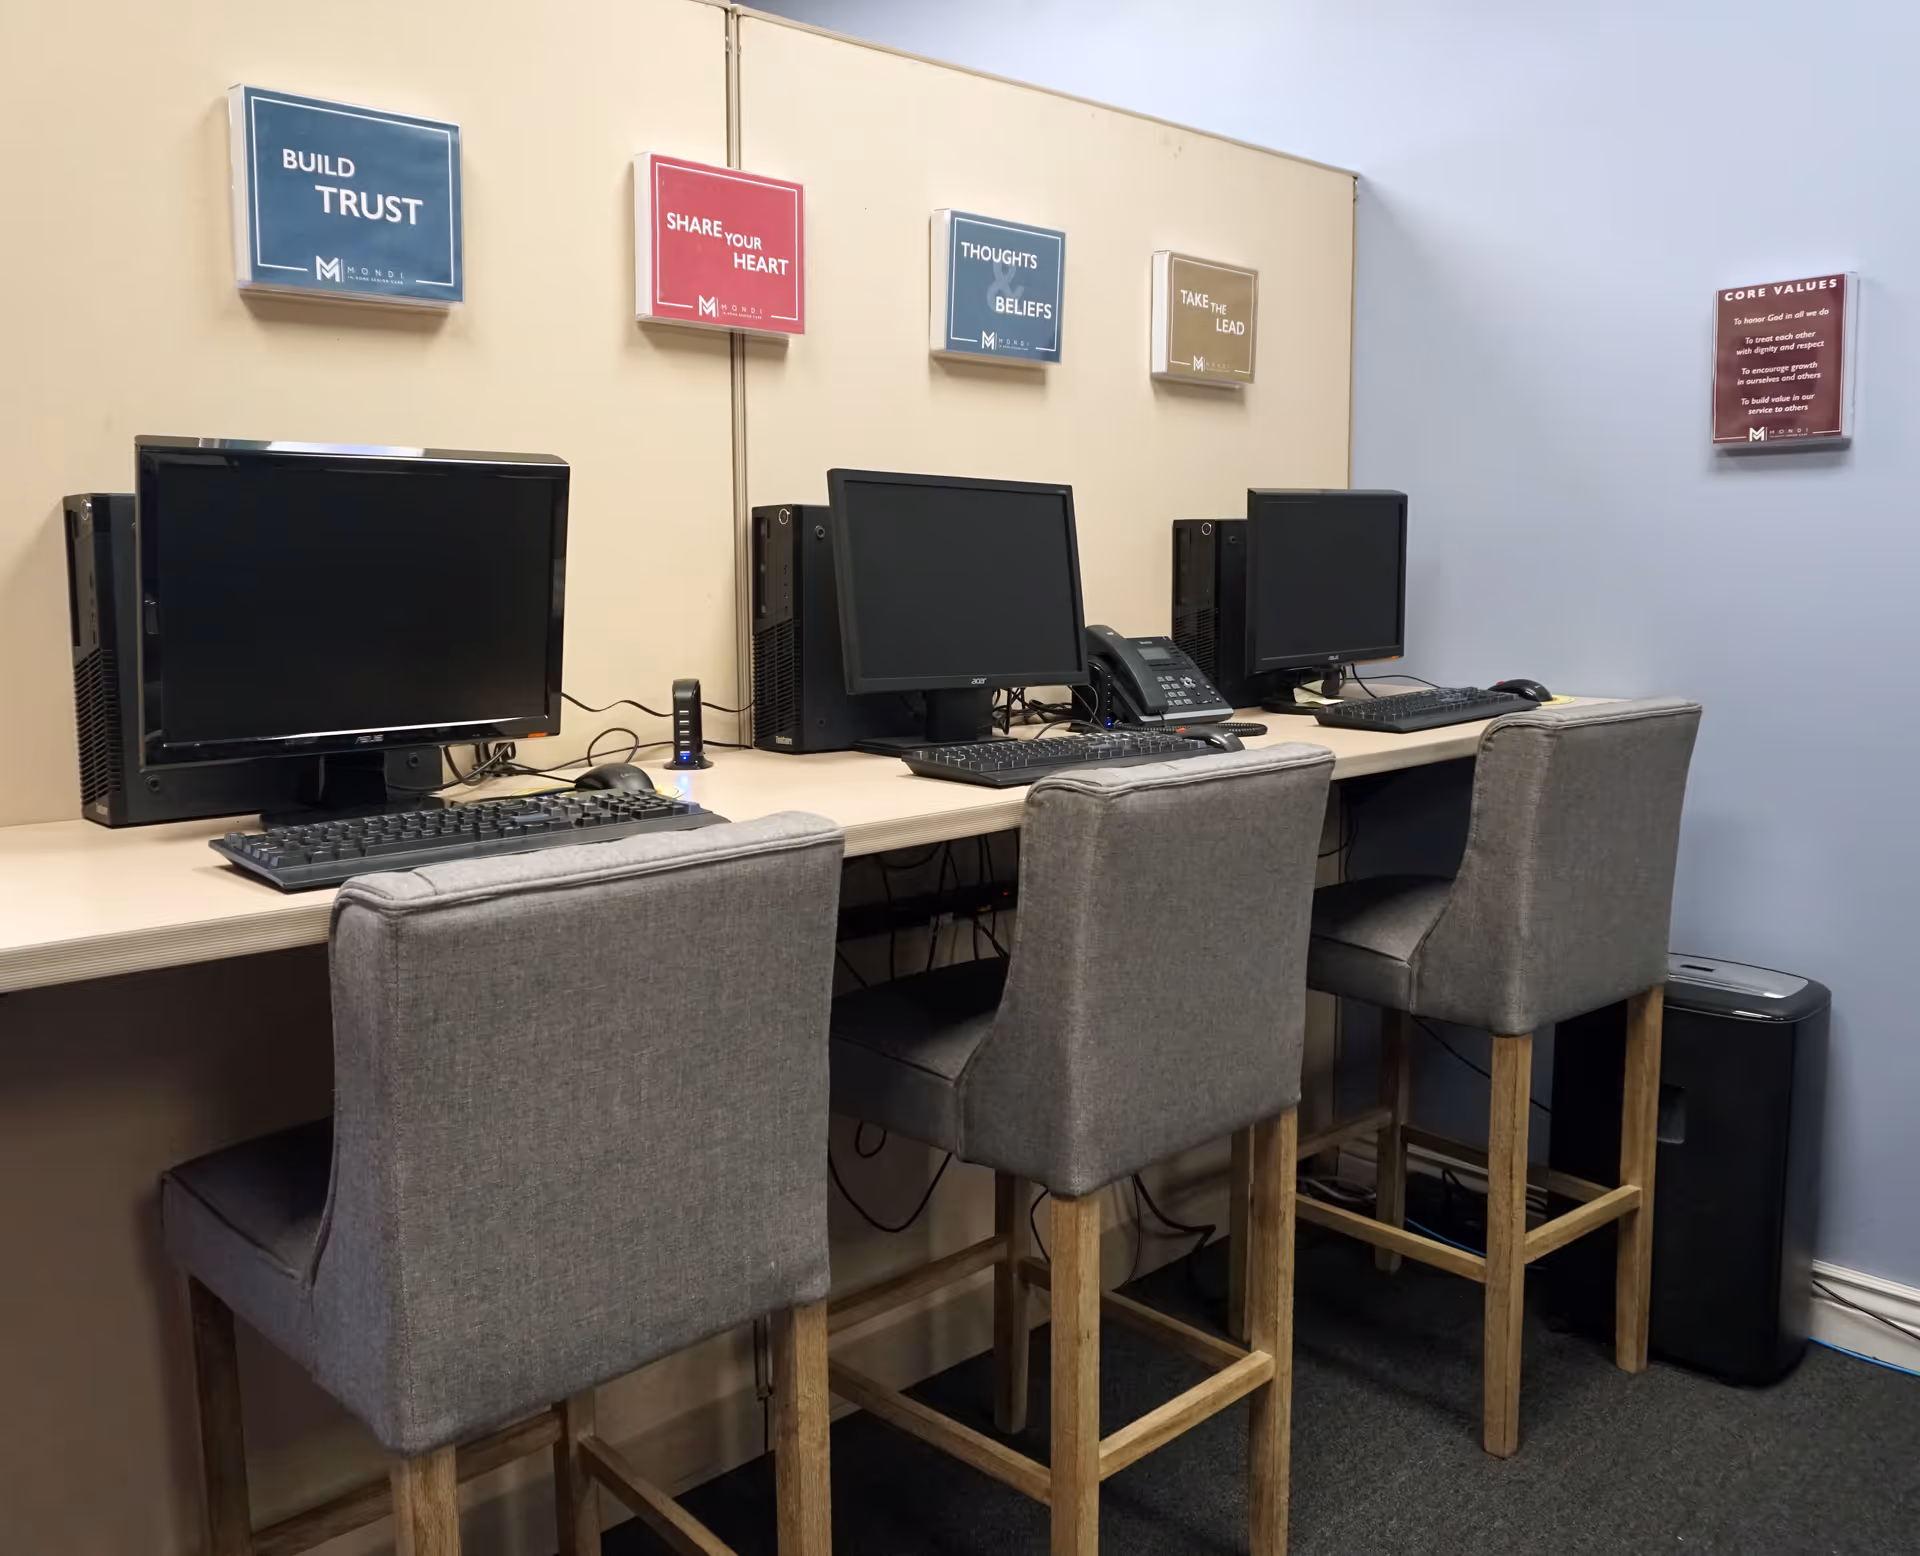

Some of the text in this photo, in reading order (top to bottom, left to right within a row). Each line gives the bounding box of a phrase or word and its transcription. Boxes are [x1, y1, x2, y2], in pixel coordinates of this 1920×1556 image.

[282, 148, 355, 178] BUILD
[315, 185, 423, 225] TRUST
[666, 212, 762, 250] SHARE YOUR
[734, 252, 789, 275] HEART
[961, 241, 1038, 269] THOUGHTS
[347, 266, 403, 279] MONDI
[1724, 279, 1837, 301] CORE VALUES
[721, 304, 762, 315] MONDI
[996, 296, 1052, 319] BELIEFS
[1180, 289, 1227, 315] TAKE THE
[1734, 318, 1742, 326] To
[1743, 316, 1765, 324] honor
[1767, 313, 1784, 322] God
[1785, 312, 1793, 320] in
[1794, 310, 1805, 319] all
[1819, 308, 1829, 316] do
[1216, 318, 1245, 335] LEAD
[1745, 331, 1816, 345] To treat each other
[1736, 340, 1825, 355] with dignity and respect
[1741, 361, 1818, 375] To encourage growth
[1746, 376, 1780, 385] ourselves
[1781, 374, 1795, 382] and
[1797, 372, 1821, 380] others
[1741, 398, 1750, 406] To
[1751, 396, 1770, 405] build
[1771, 395, 1790, 403] value
[1748, 404, 1808, 415] service to others
[971, 677, 987, 685] acer
